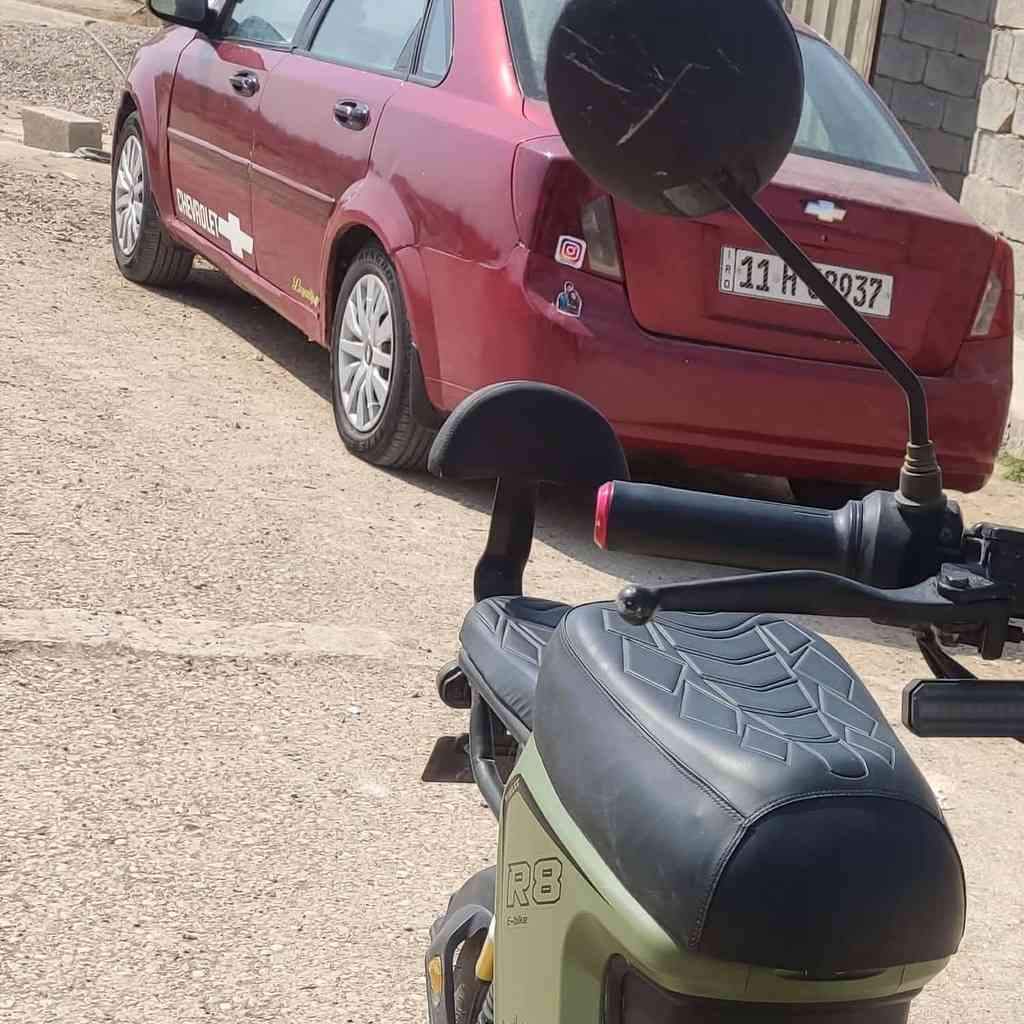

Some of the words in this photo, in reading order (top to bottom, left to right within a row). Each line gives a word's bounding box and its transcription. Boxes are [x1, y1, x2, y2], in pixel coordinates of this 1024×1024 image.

[176, 188, 220, 239] CHEVROLET
[739, 256, 771, 293] 11
[506, 857, 563, 908] R8
